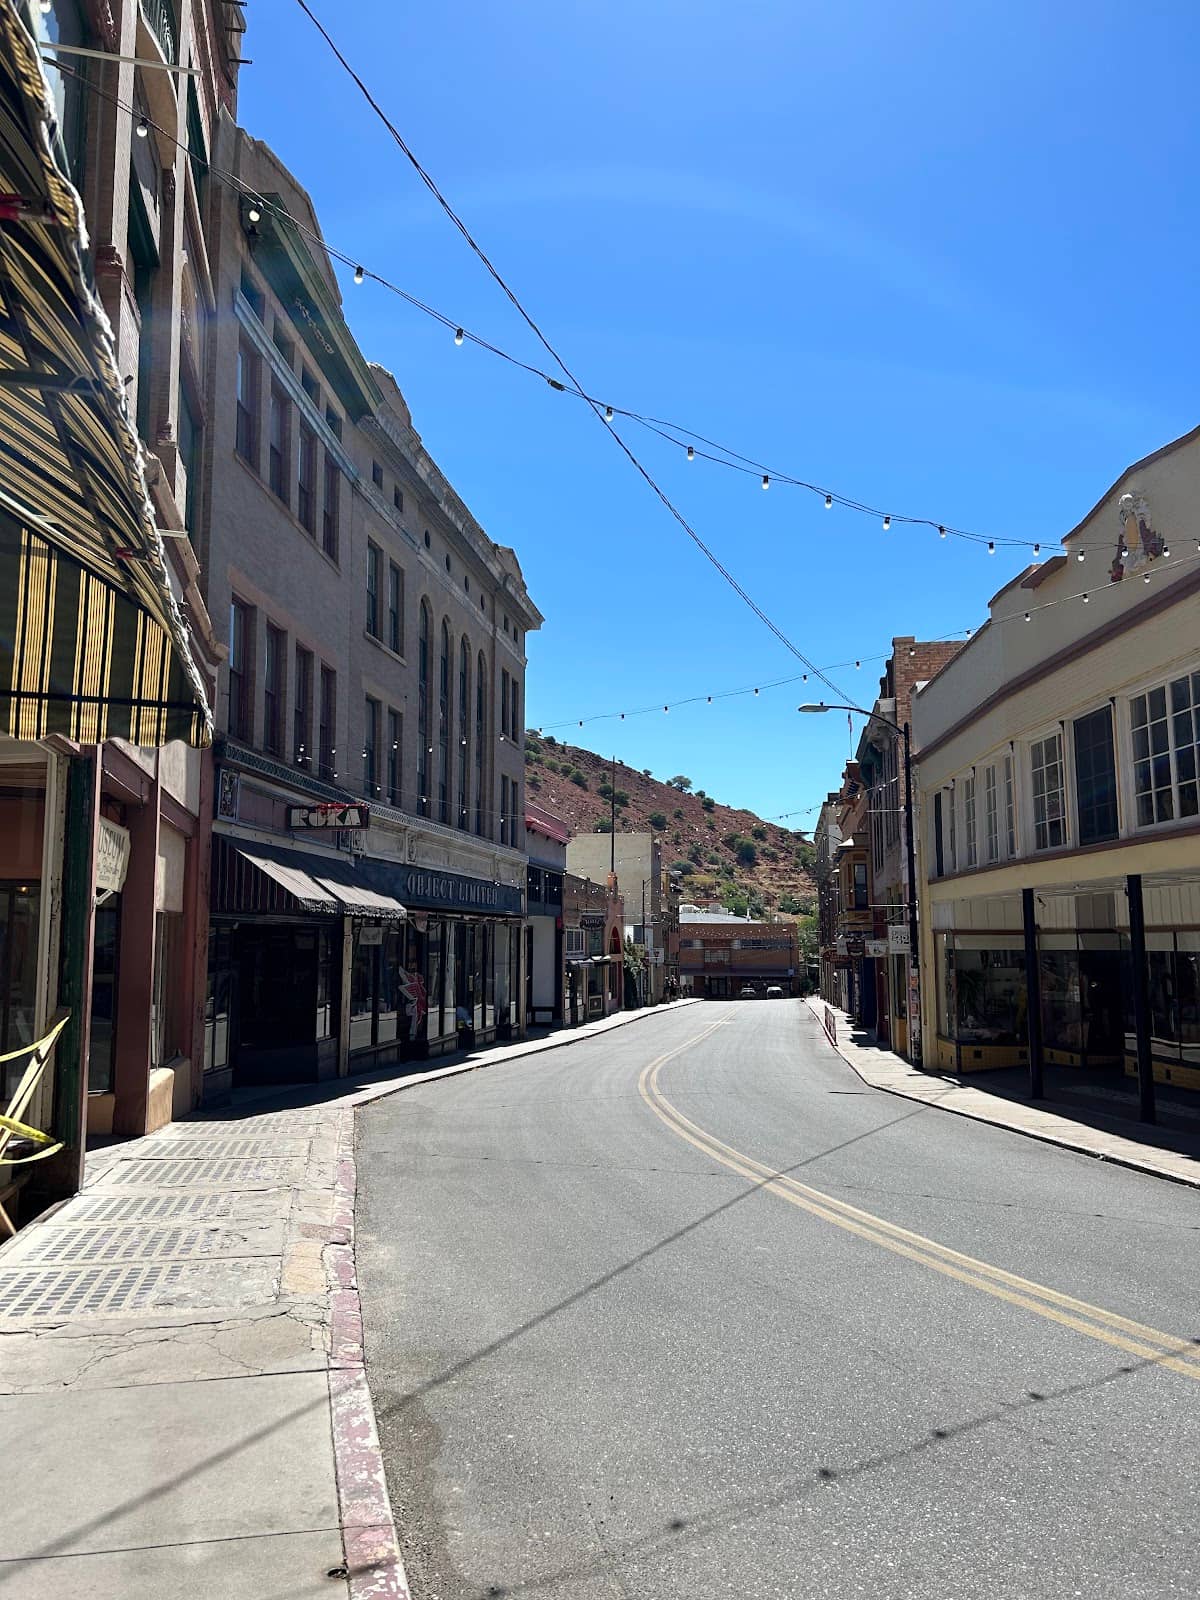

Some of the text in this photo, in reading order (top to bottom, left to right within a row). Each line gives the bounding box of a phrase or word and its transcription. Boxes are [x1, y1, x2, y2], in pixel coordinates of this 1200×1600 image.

[290, 808, 362, 827] ROKA
[98, 826, 125, 860] USEUM
[407, 873, 498, 905] OBJECT LIMITED
